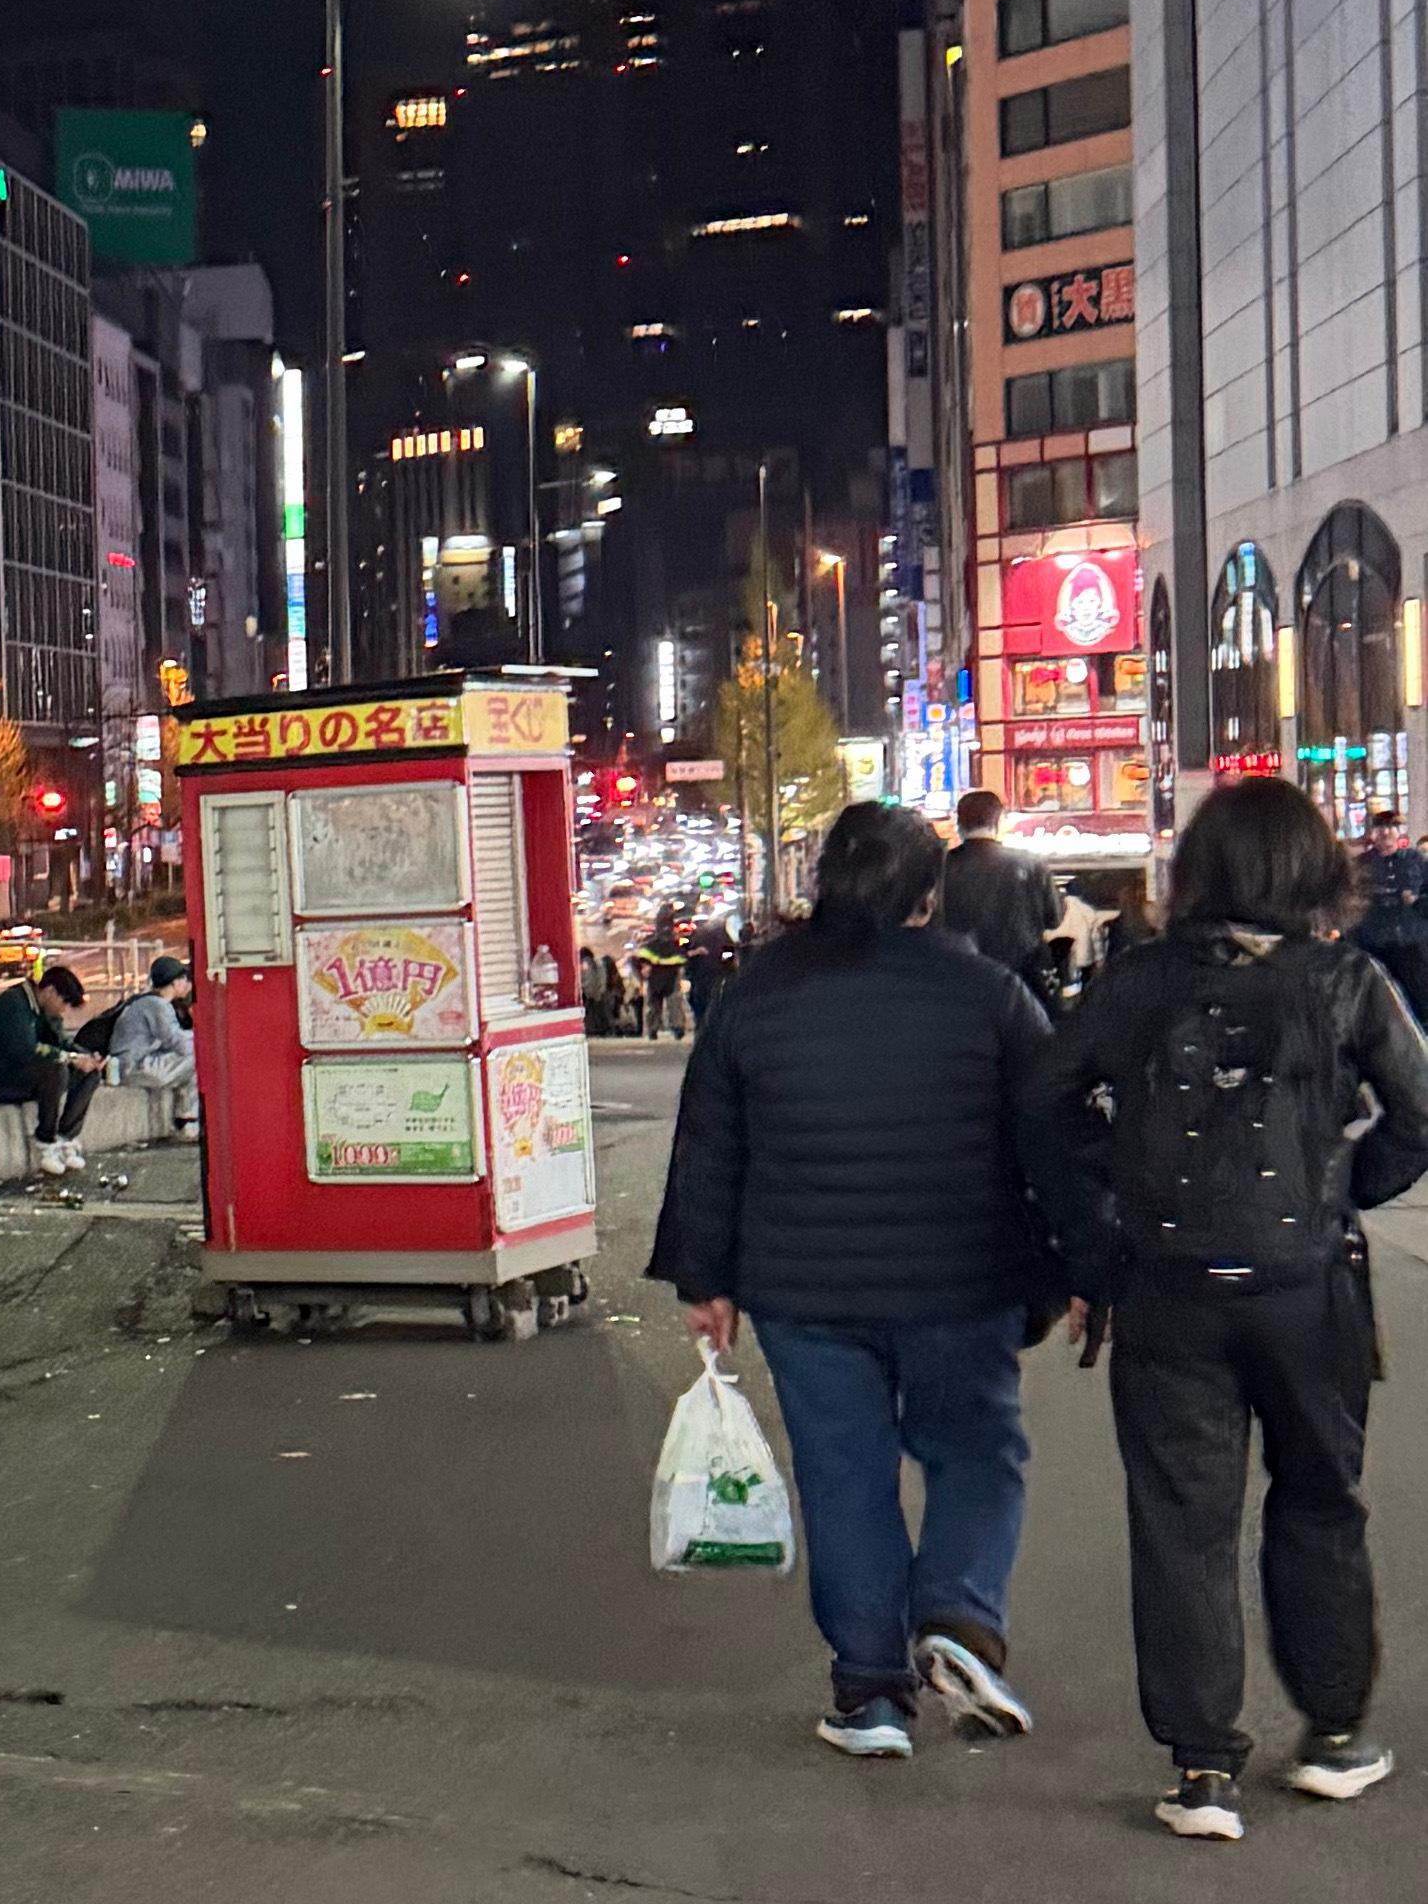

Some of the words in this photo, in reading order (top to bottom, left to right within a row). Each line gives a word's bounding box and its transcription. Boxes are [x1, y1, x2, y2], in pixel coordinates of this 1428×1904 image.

[114, 167, 174, 192] MIWA
[190, 703, 451, 764] 大当りの名店
[487, 696, 545, 744] 宝くじ
[325, 956, 444, 1000] 1億円
